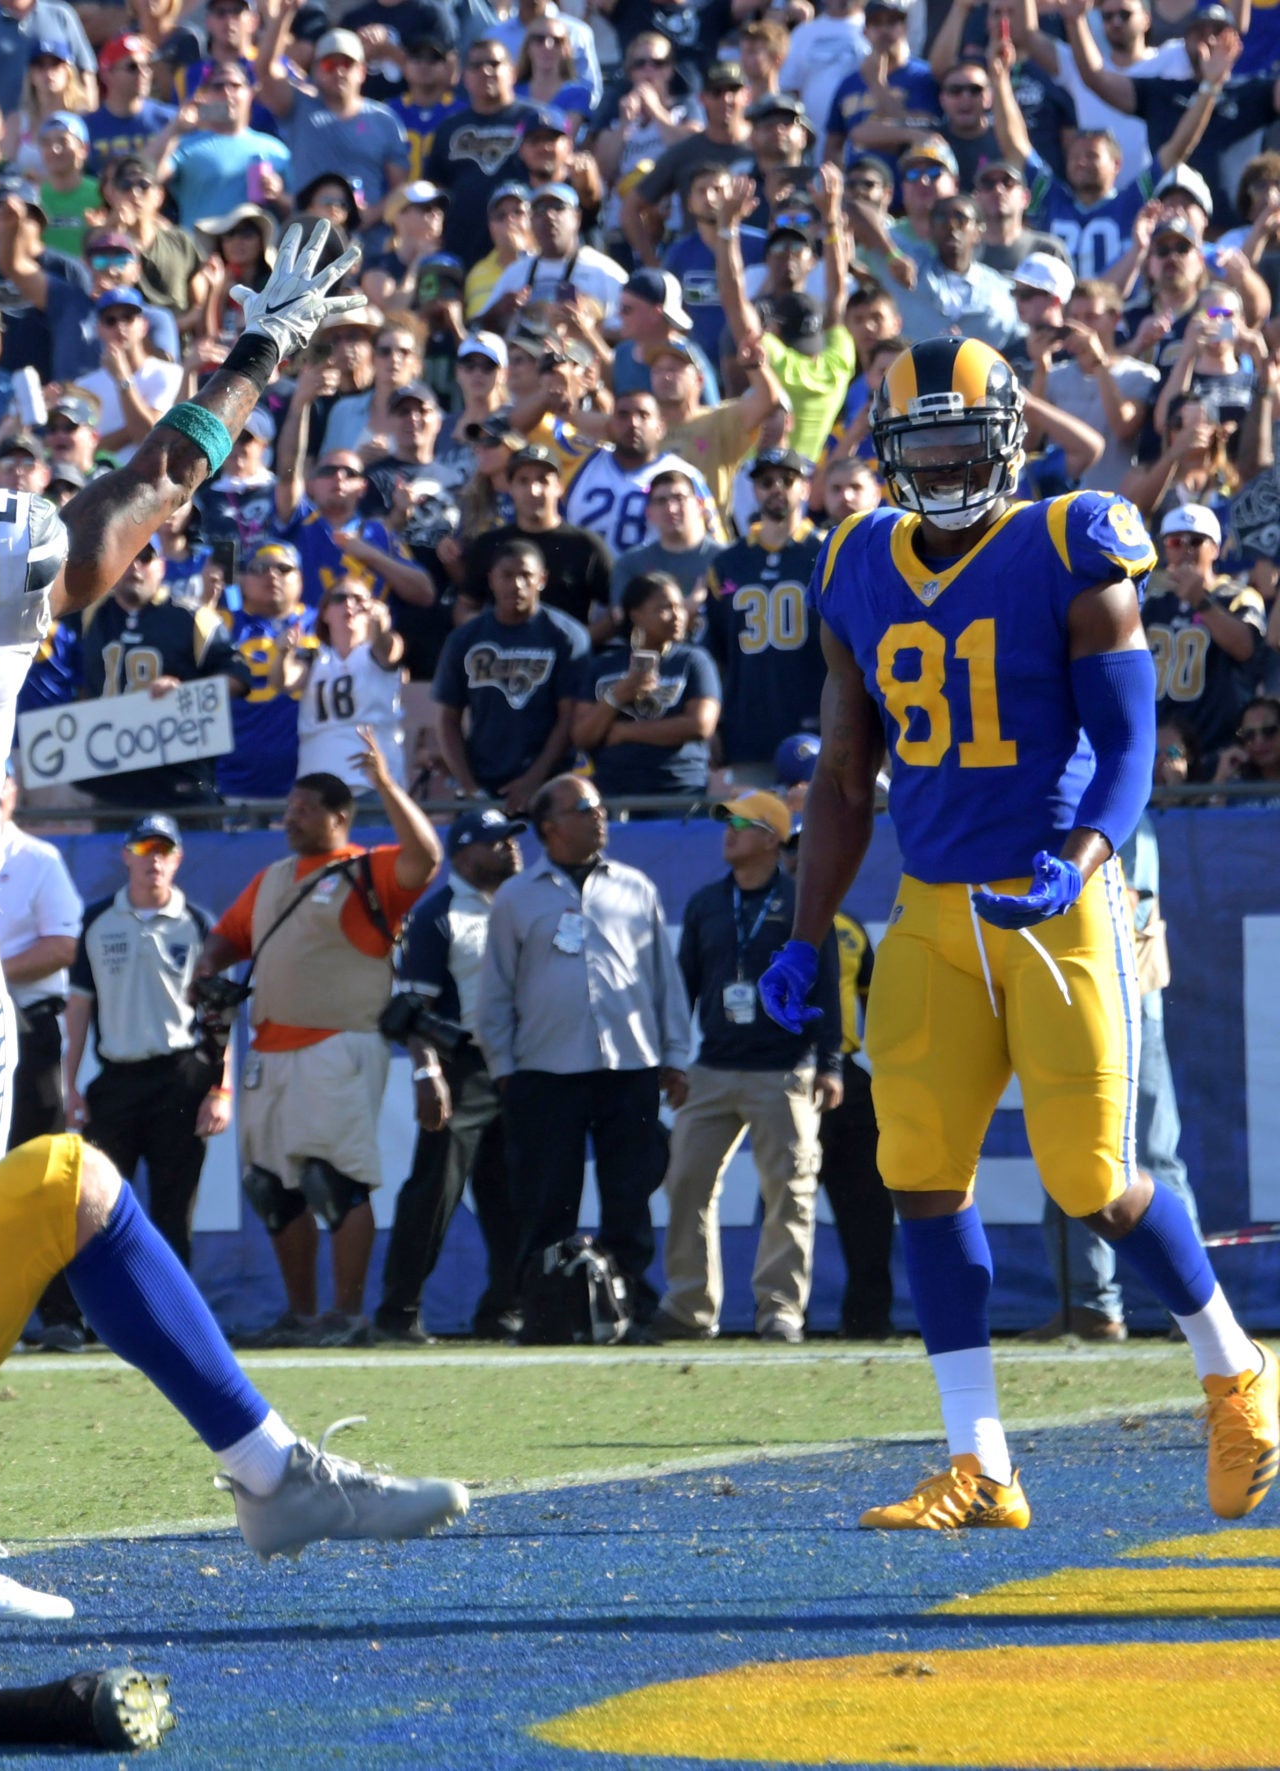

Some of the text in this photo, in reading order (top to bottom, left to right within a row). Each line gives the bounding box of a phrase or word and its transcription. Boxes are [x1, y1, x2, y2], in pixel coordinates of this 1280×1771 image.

[732, 580, 807, 654] 30
[176, 682, 220, 716] #18
[317, 675, 355, 722] 18
[876, 618, 1018, 768] 81
[85, 717, 215, 772] Cooper
